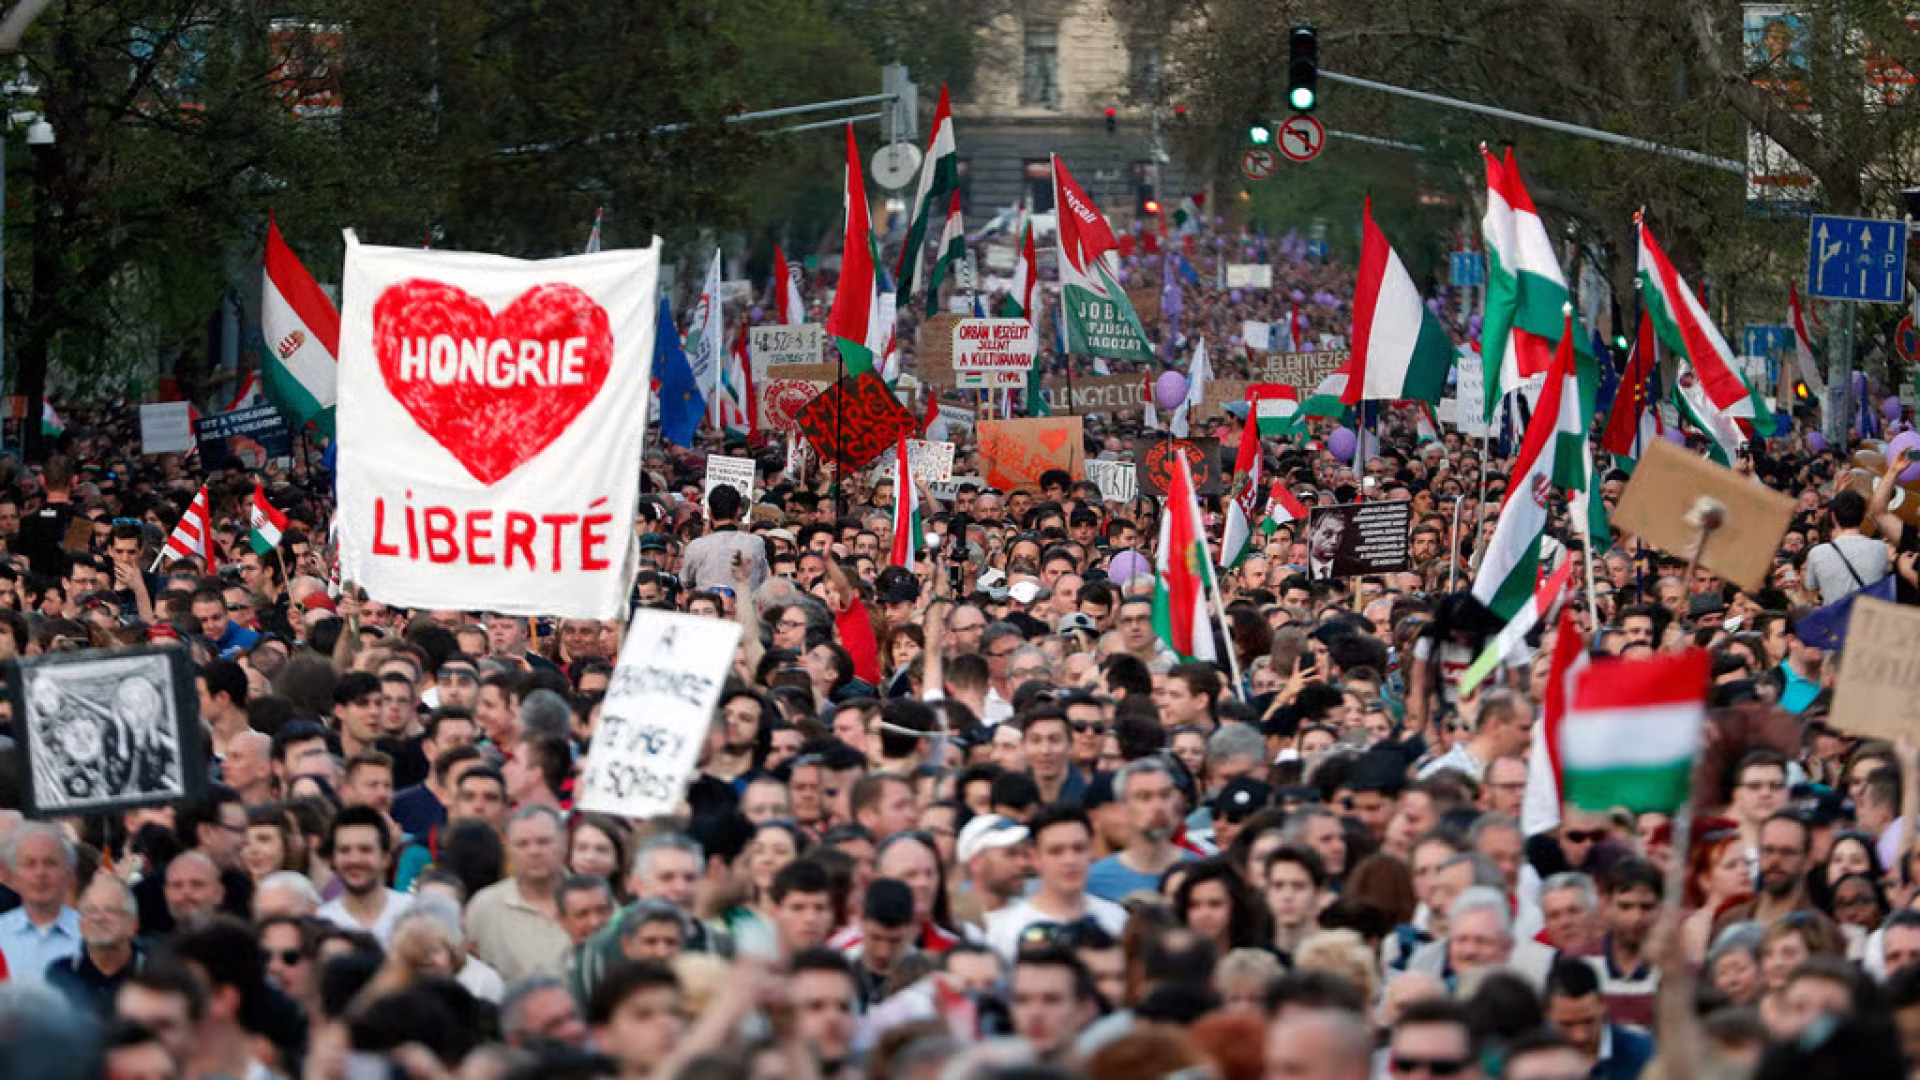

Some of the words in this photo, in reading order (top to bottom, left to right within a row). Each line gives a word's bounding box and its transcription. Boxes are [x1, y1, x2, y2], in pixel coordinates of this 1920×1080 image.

[1884, 253, 1896, 269] P
[959, 321, 991, 340] ORBÁN
[993, 321, 1030, 339] VESZÉLYT
[400, 333, 588, 389] HONGRIE
[959, 352, 968, 367] A
